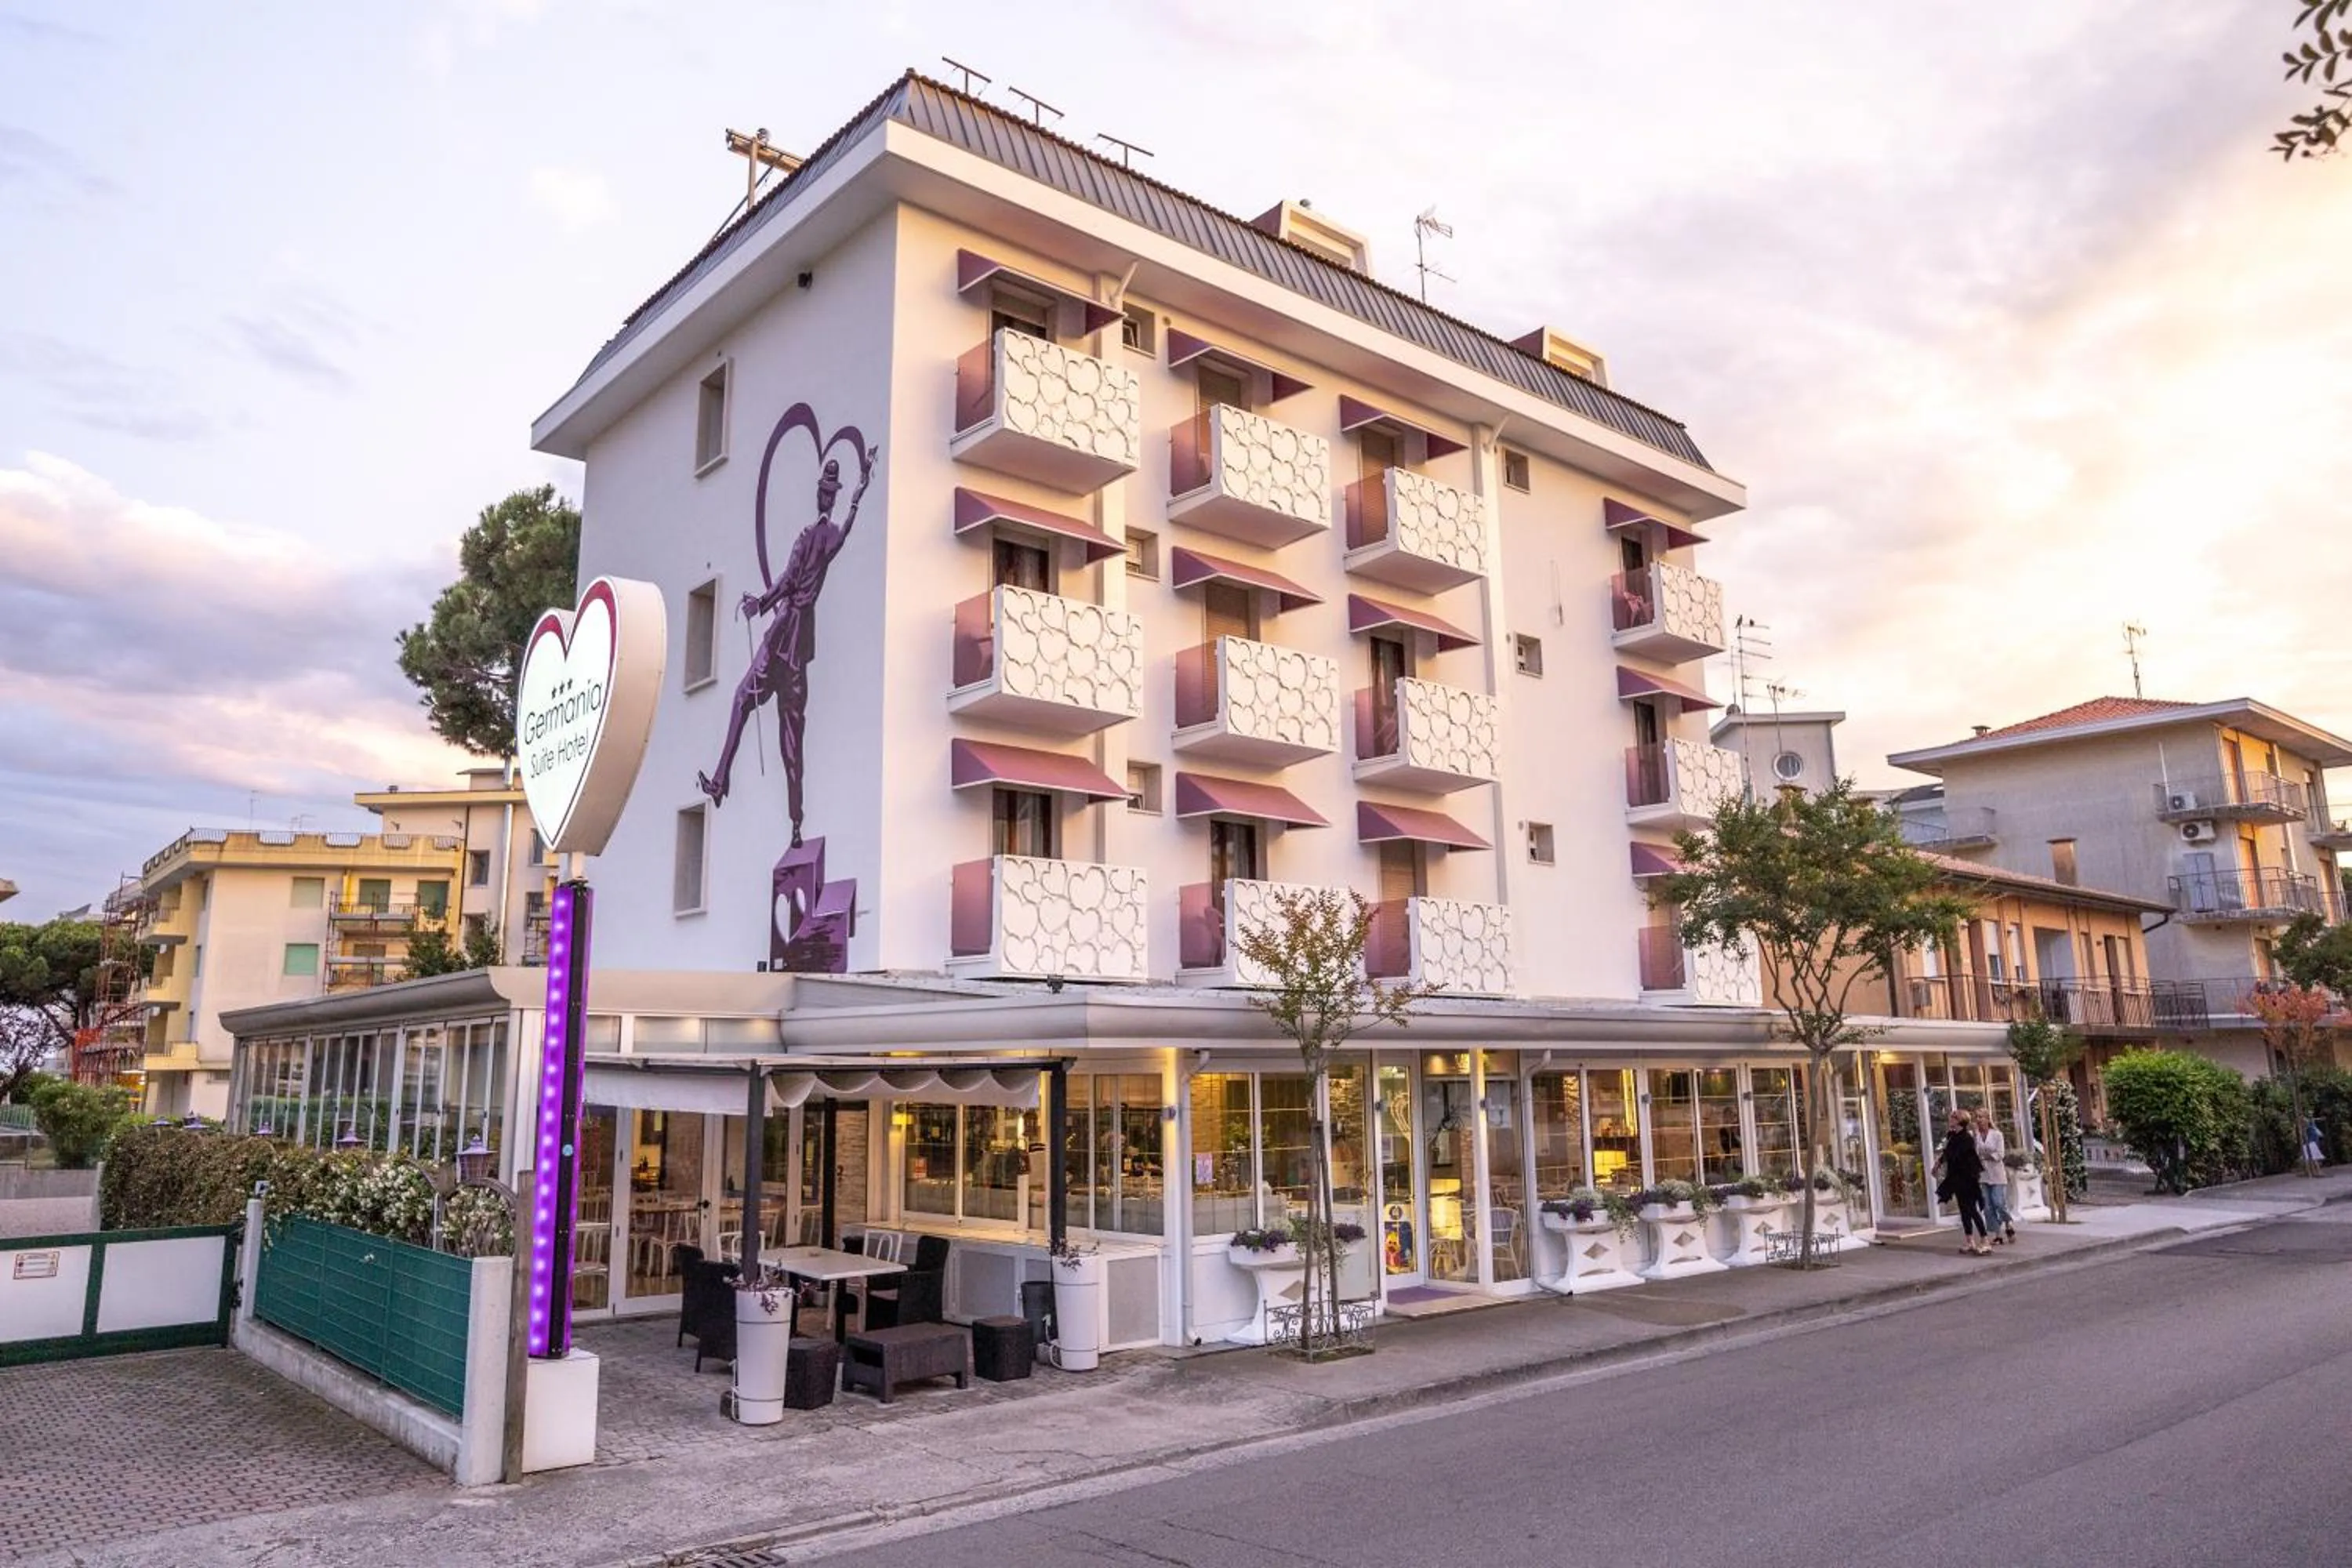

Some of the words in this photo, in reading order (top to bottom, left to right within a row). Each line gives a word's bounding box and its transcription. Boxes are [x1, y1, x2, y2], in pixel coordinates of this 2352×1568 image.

[524, 679, 602, 746] Germania
[531, 746, 554, 779] Suite
[557, 727, 589, 767] Hotel
